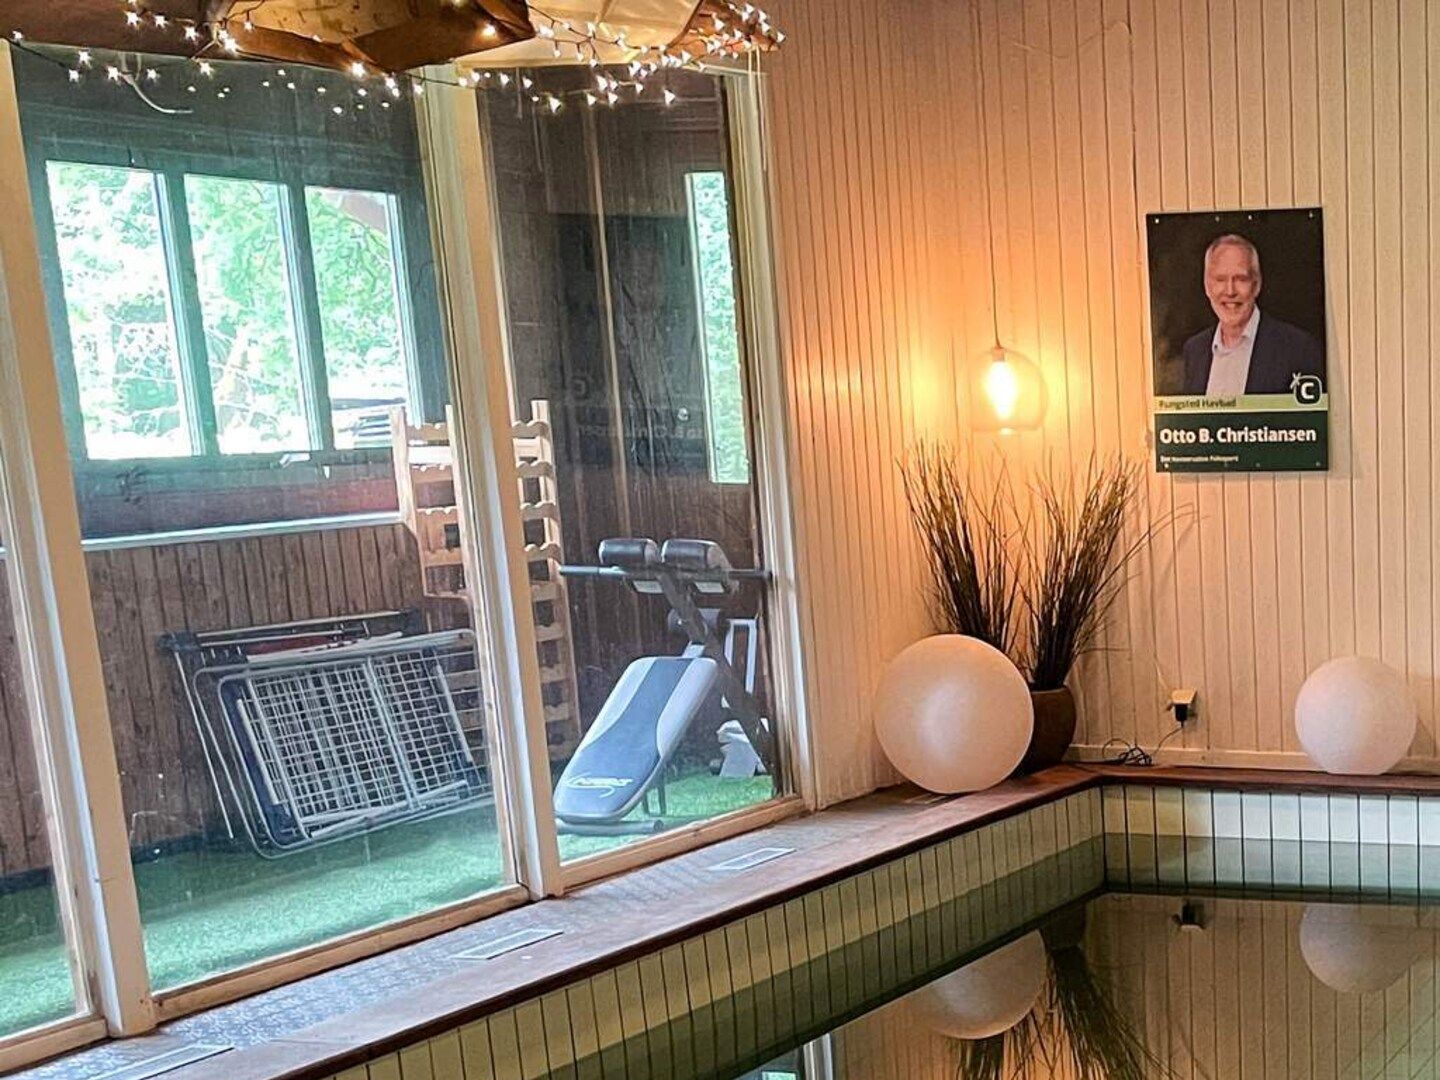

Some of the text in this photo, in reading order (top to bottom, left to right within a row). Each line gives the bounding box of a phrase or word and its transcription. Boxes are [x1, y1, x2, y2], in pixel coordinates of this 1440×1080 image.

[1301, 382, 1315, 400] C
[1159, 426, 1317, 444] Otto B. Christiansen
